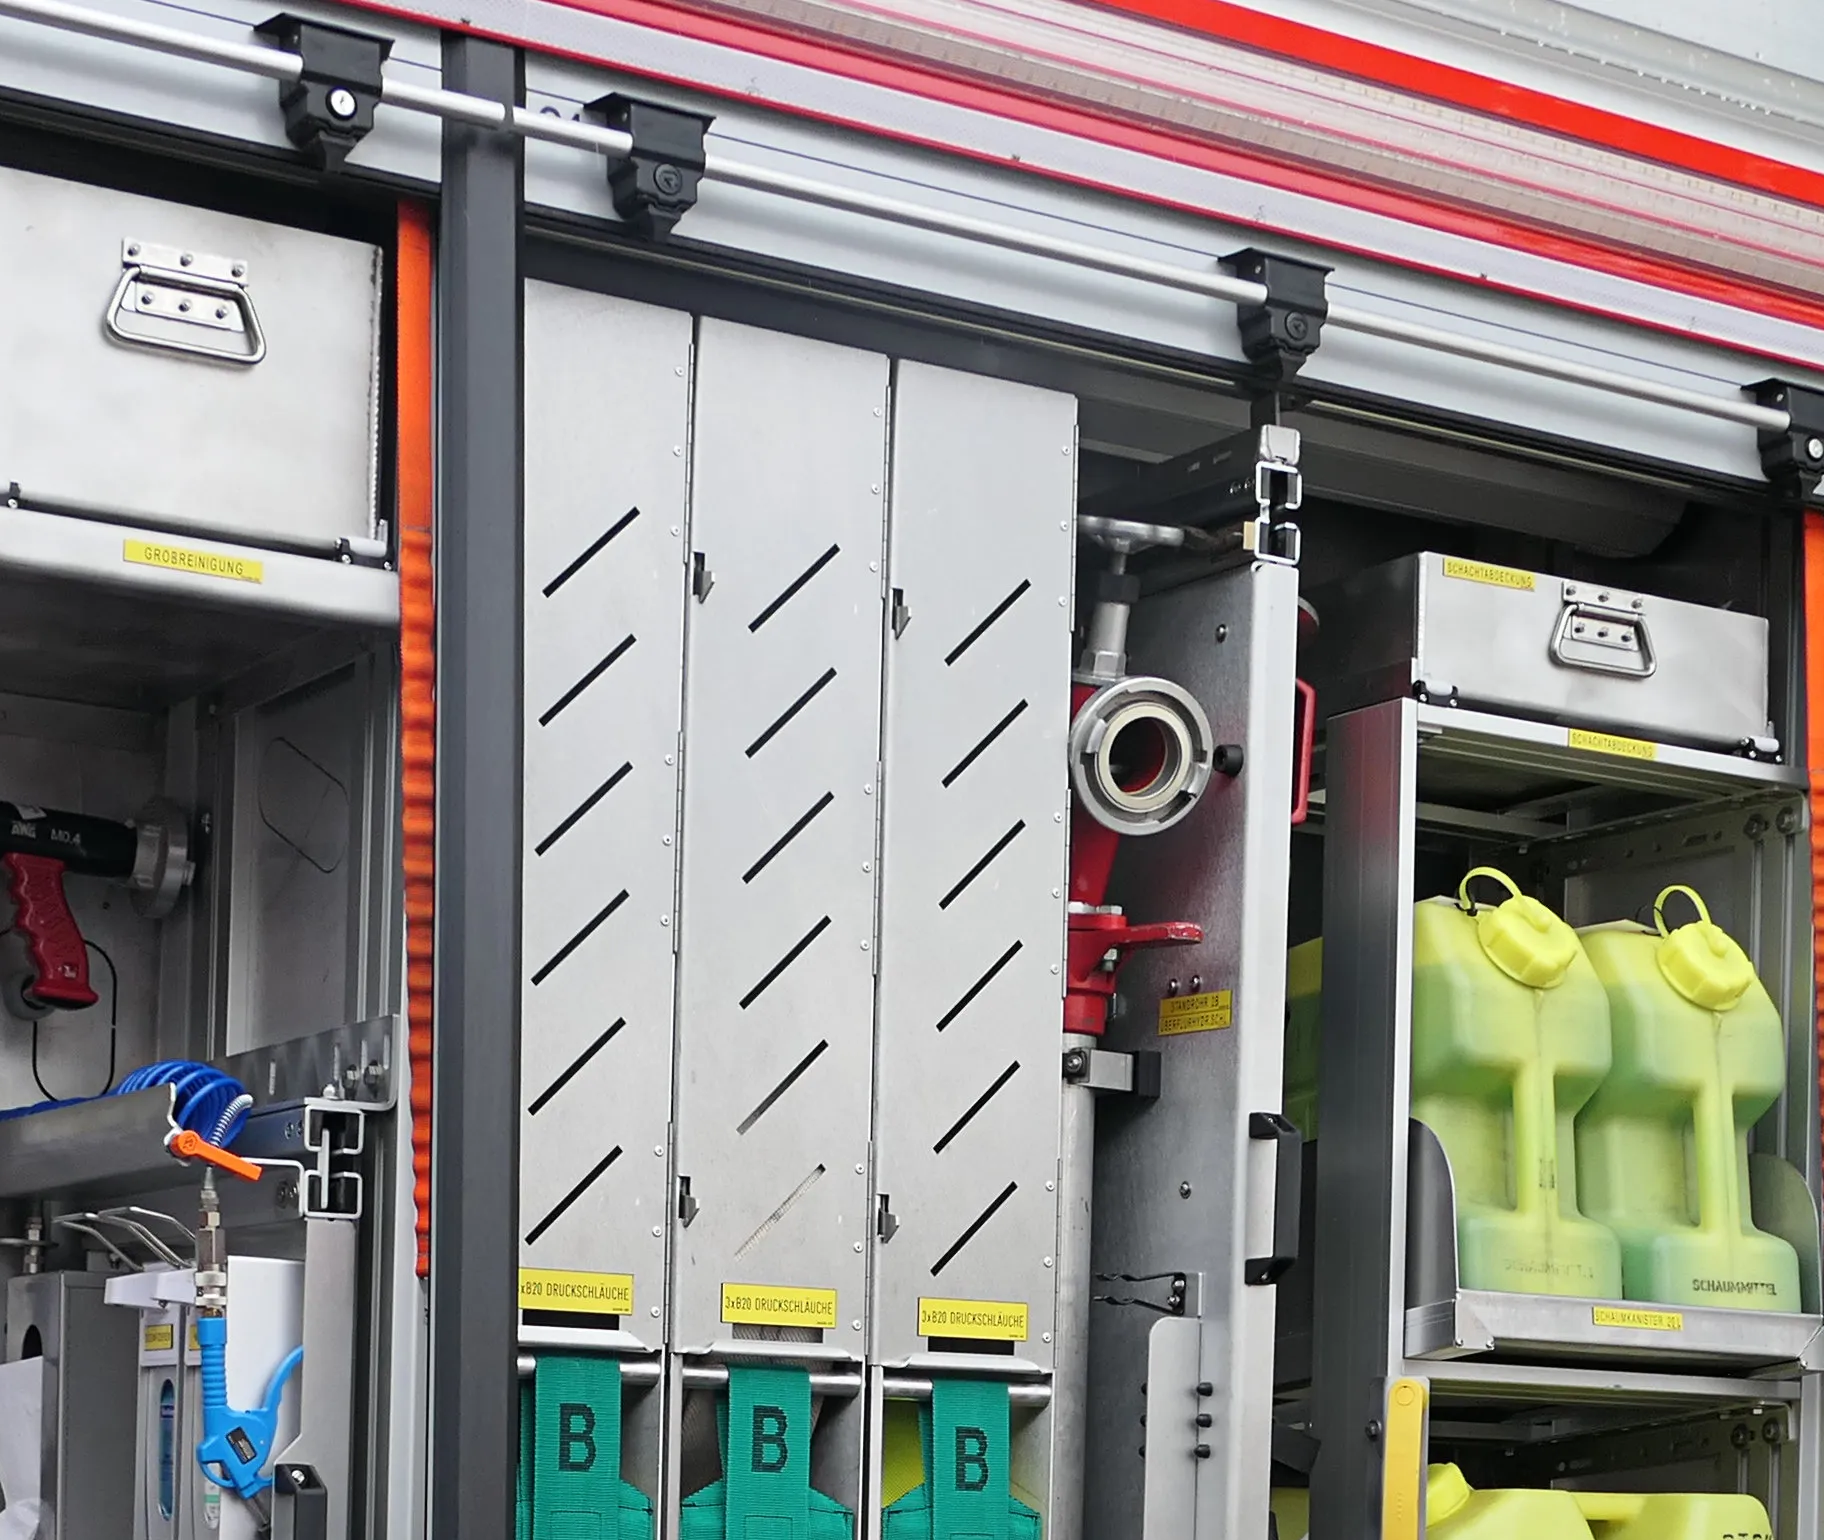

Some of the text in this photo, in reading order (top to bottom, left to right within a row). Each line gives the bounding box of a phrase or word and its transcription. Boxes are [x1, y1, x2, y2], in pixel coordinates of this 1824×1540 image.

[144, 547, 244, 575] GROBREINIGUNG
[1446, 561, 1532, 588] SCHACHTABDECKUNG
[521, 1281, 629, 1301] xB20 DRUCKSCHLÄUCHE
[1692, 1278, 1778, 1296] SCHAUMMITTEL
[755, 1296, 832, 1315] DRUCKSCHLÄUCHE
[950, 1310, 1024, 1329] DRUCKSCHLÄUCHE
[1595, 1309, 1663, 1326] SCHAUMKANISTER
[557, 1403, 597, 1472] B
[751, 1404, 789, 1472] B
[953, 1426, 988, 1492] B
